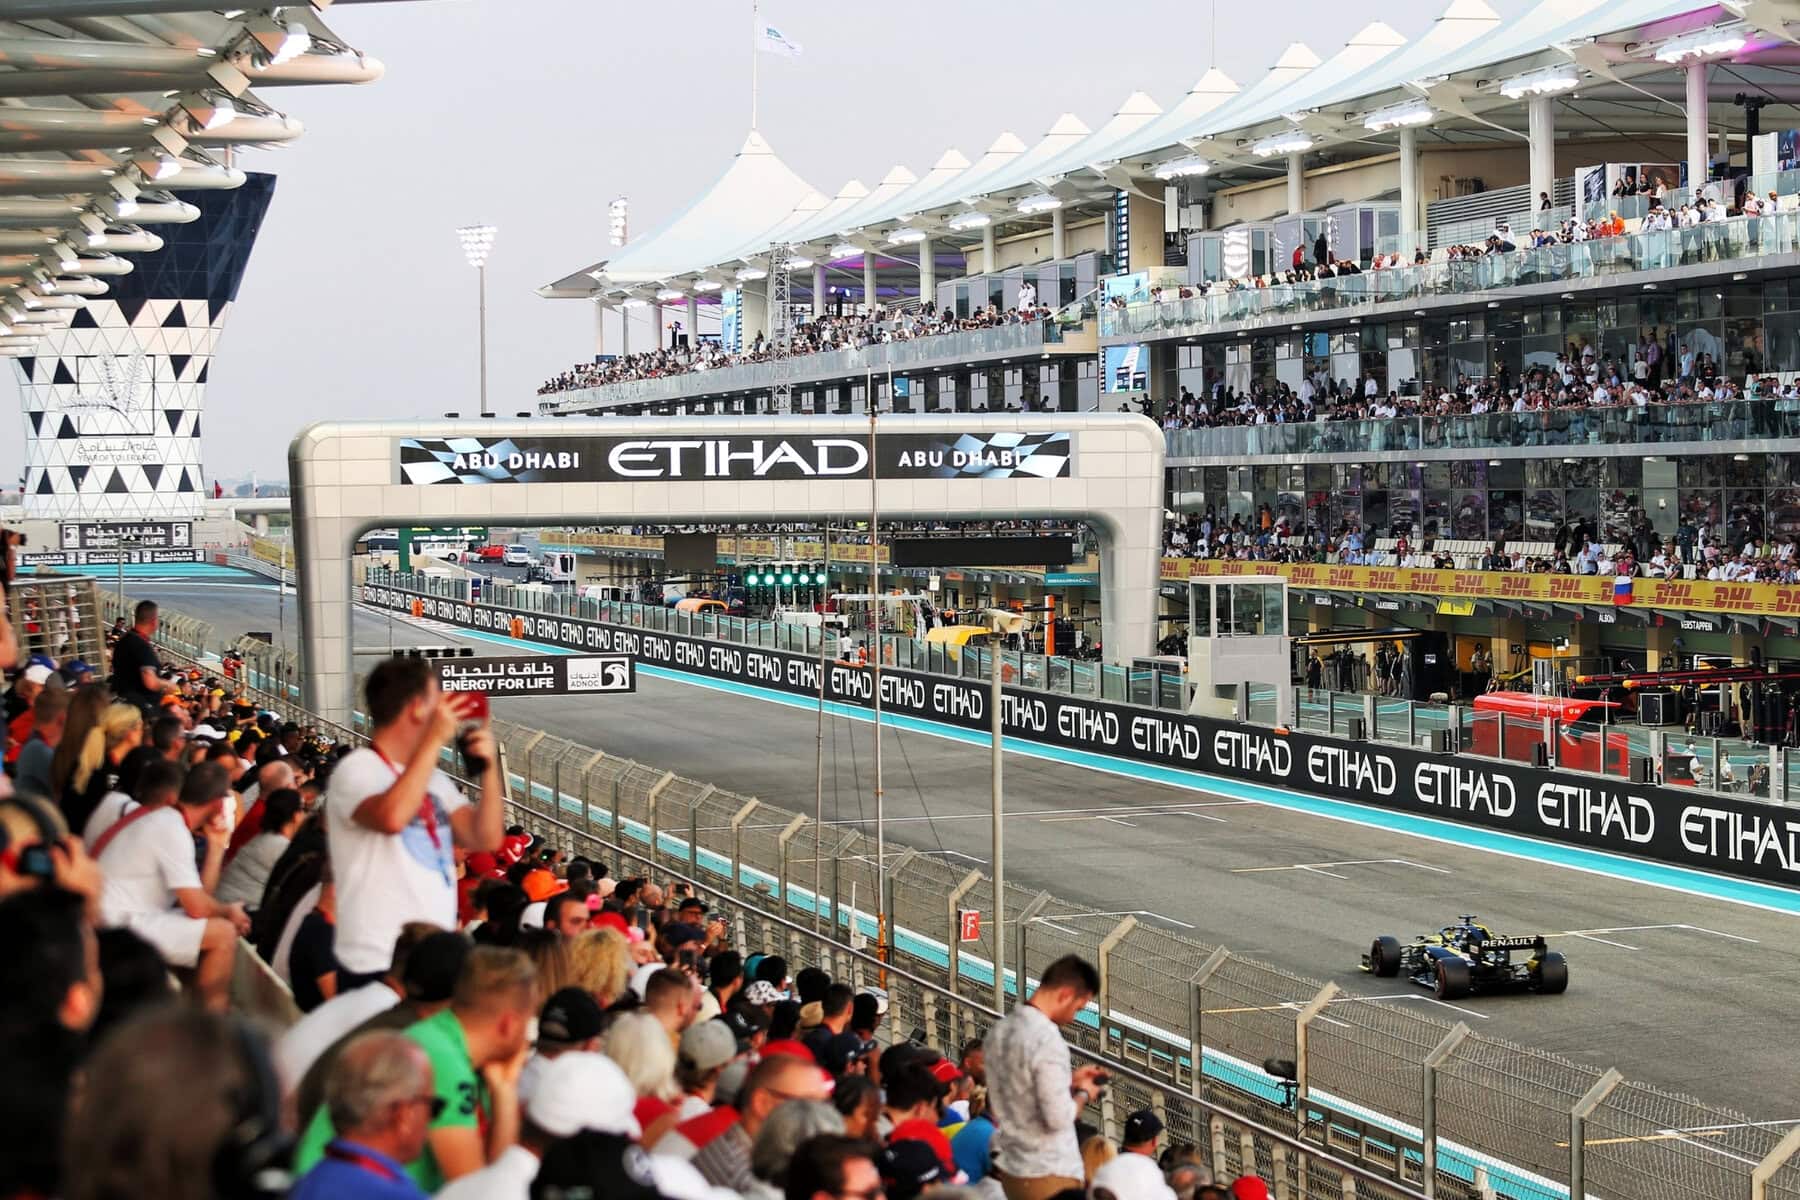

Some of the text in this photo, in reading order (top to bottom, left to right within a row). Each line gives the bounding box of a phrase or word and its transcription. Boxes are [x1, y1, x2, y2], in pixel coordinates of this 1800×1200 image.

[453, 451, 580, 470] ABU DHABI
[608, 439, 869, 477] ETIHAD
[898, 449, 1021, 467] ABU DHABI
[145, 537, 166, 545] LIFE
[1160, 561, 1181, 577] DHL
[1189, 561, 1210, 577] DHL
[1221, 563, 1243, 576] DHL
[1256, 565, 1279, 576] DHL
[1291, 566, 1316, 585] DHL
[1329, 568, 1356, 587] DHL
[1368, 570, 1397, 590] DHL
[1410, 572, 1440, 592] DHL
[1454, 574, 1486, 595] DHL
[1500, 576, 1533, 597] DHL
[1550, 578, 1584, 600] DHL
[1655, 583, 1695, 606] DHL
[1714, 586, 1754, 609] DHL
[438, 601, 454, 620] ETIHAD
[455, 604, 472, 624] ETIHAD
[474, 608, 492, 628] ETIHAD
[537, 618, 559, 640] ETIHAD
[561, 623, 584, 645] ETIHAD
[1680, 619, 1713, 632] VERSTAPPEN
[586, 626, 611, 650] ETIHAD
[613, 631, 640, 655] ETIHAD
[643, 636, 671, 661] ETIHAD
[675, 641, 705, 668] ETIHAD
[709, 647, 742, 674] ETIHAD
[442, 662, 555, 679] طاقة للحياة
[746, 652, 782, 682] ETIHAD
[442, 677, 554, 691] ENERGY FOR LIFE
[570, 680, 600, 688] ADNOC
[831, 667, 873, 699] ETIHAD
[880, 675, 926, 709] ETIHAD
[933, 683, 983, 720] ETIHAD
[1000, 694, 1047, 732] TIHAD
[1057, 704, 1119, 746] ETIHAD
[1131, 715, 1200, 760] ETIHAD
[1213, 730, 1292, 777] ETIHAD
[1307, 744, 1397, 797] ETIHAD
[1414, 761, 1517, 818] ETIHAD
[1537, 782, 1656, 844] ETIHAD
[1481, 936, 1537, 948] RENAULT
